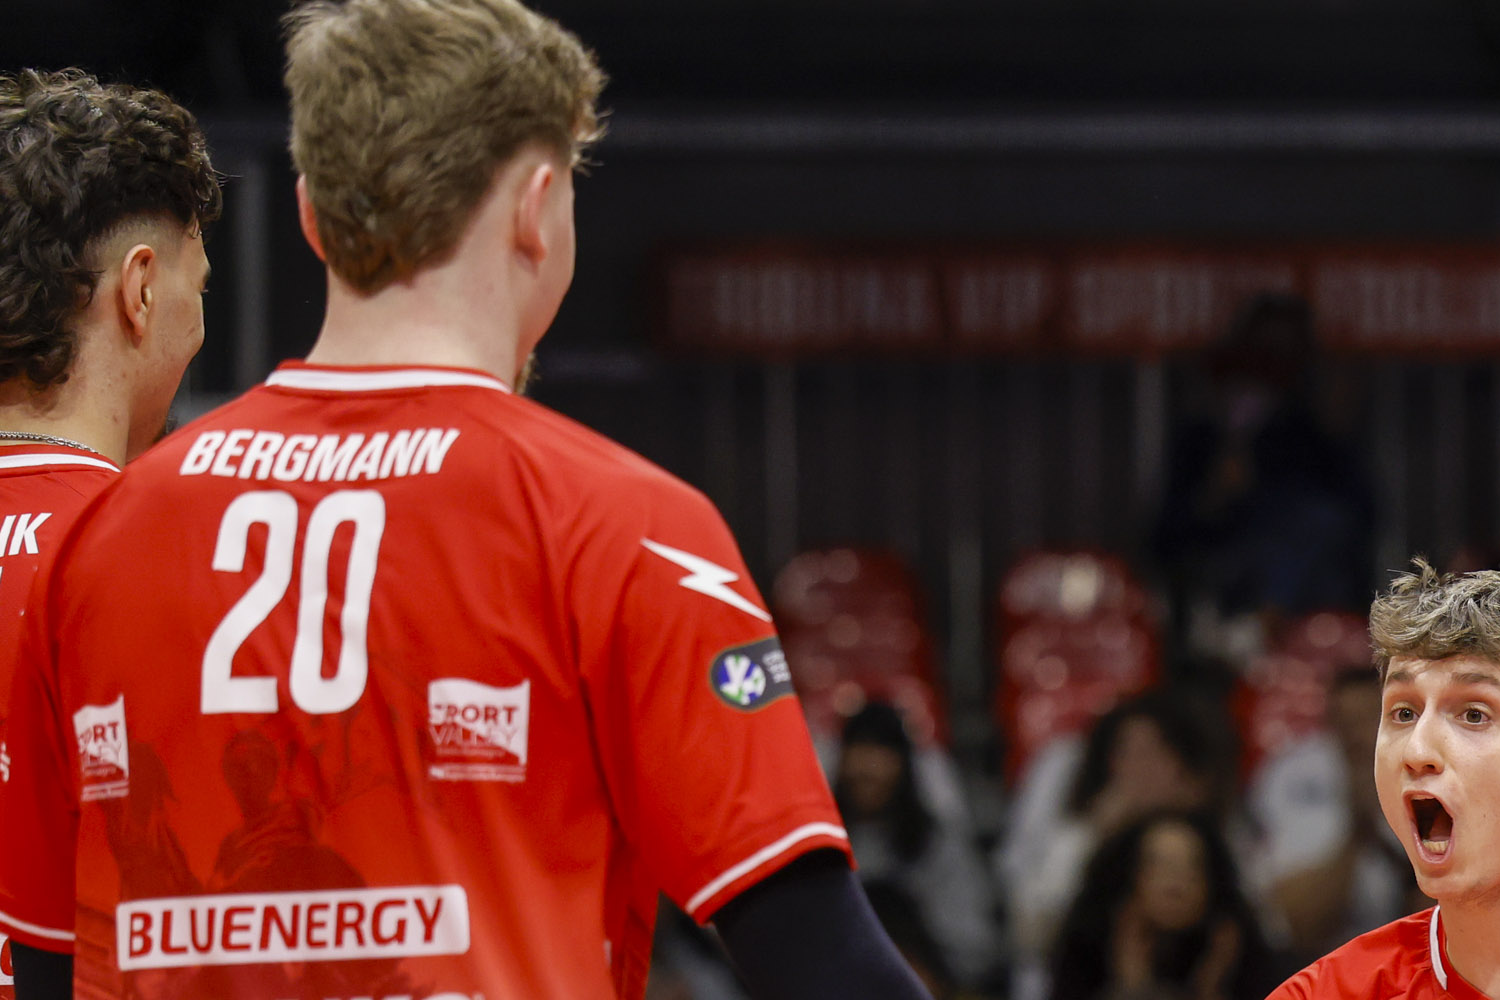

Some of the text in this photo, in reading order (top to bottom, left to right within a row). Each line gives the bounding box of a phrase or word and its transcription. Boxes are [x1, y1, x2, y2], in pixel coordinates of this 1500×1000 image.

[180, 428, 460, 482] BERGMANN
[200, 489, 387, 715] 20
[128, 897, 445, 958] BLUENERGY
